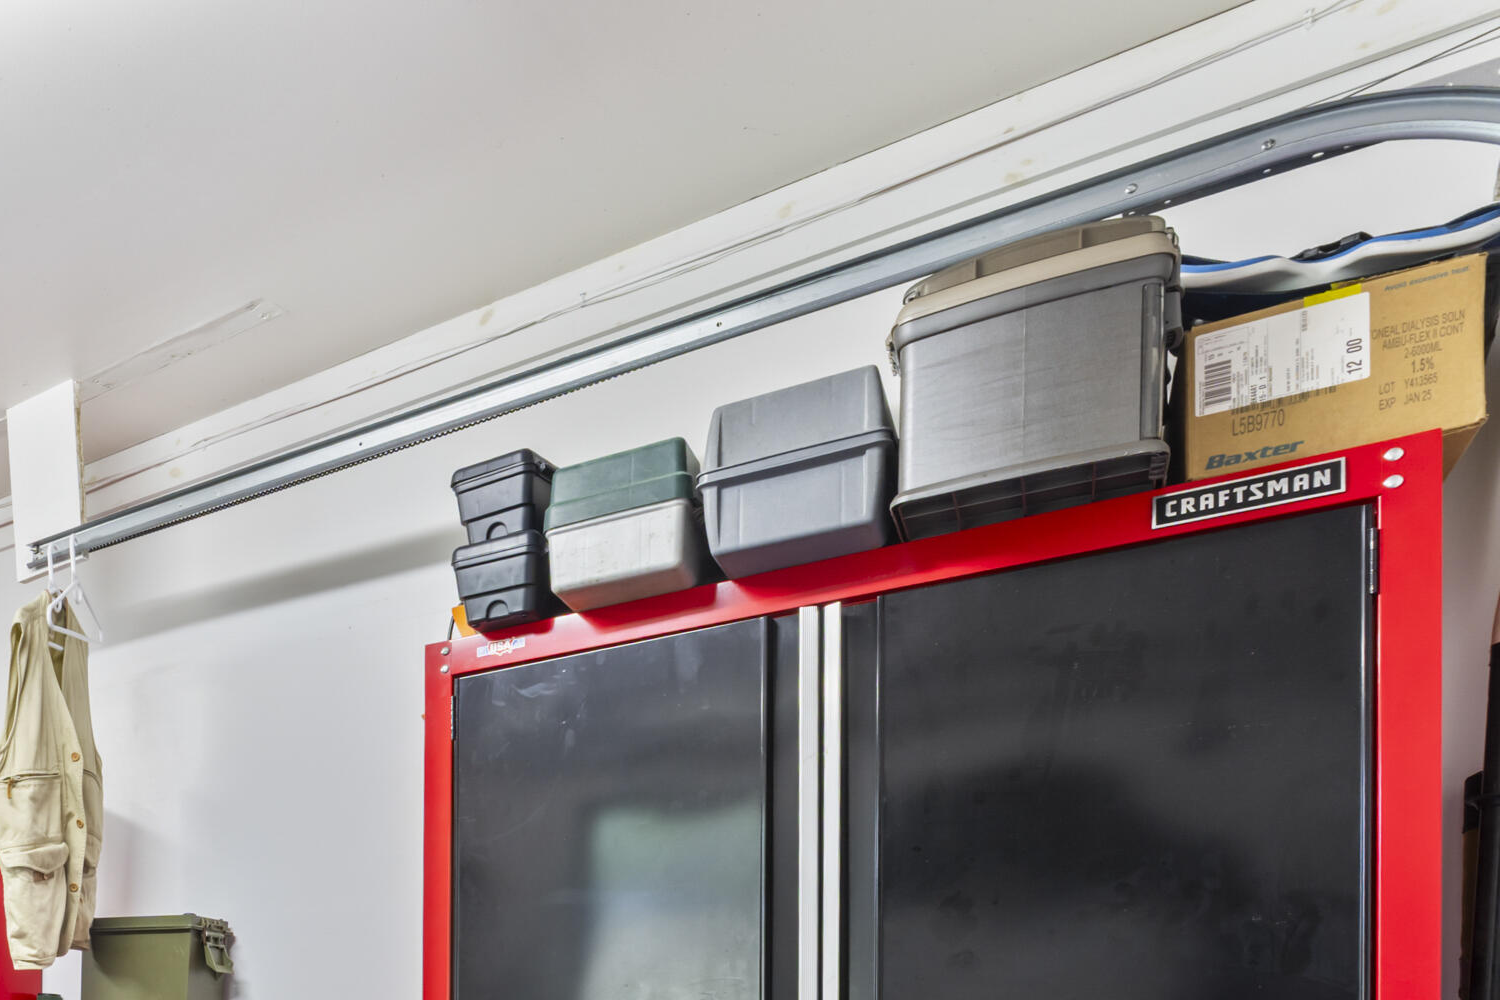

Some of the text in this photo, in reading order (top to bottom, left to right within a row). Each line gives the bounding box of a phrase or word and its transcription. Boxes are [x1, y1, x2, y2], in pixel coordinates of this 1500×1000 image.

[1384, 280, 1407, 292] Avoid
[1409, 271, 1449, 286] excessive
[1370, 308, 1466, 341] ONEAL DIALYSIS SOLN
[1439, 321, 1464, 338] CONT
[1346, 359, 1363, 375] 12
[1411, 356, 1435, 374] 1.5%
[1378, 381, 1396, 396] LOT
[1378, 389, 1433, 411] EXP JAN 25
[1231, 408, 1285, 437] L5B9770
[1205, 440, 1305, 471] Baxter
[1165, 468, 1332, 518] CRAFTSMAN
